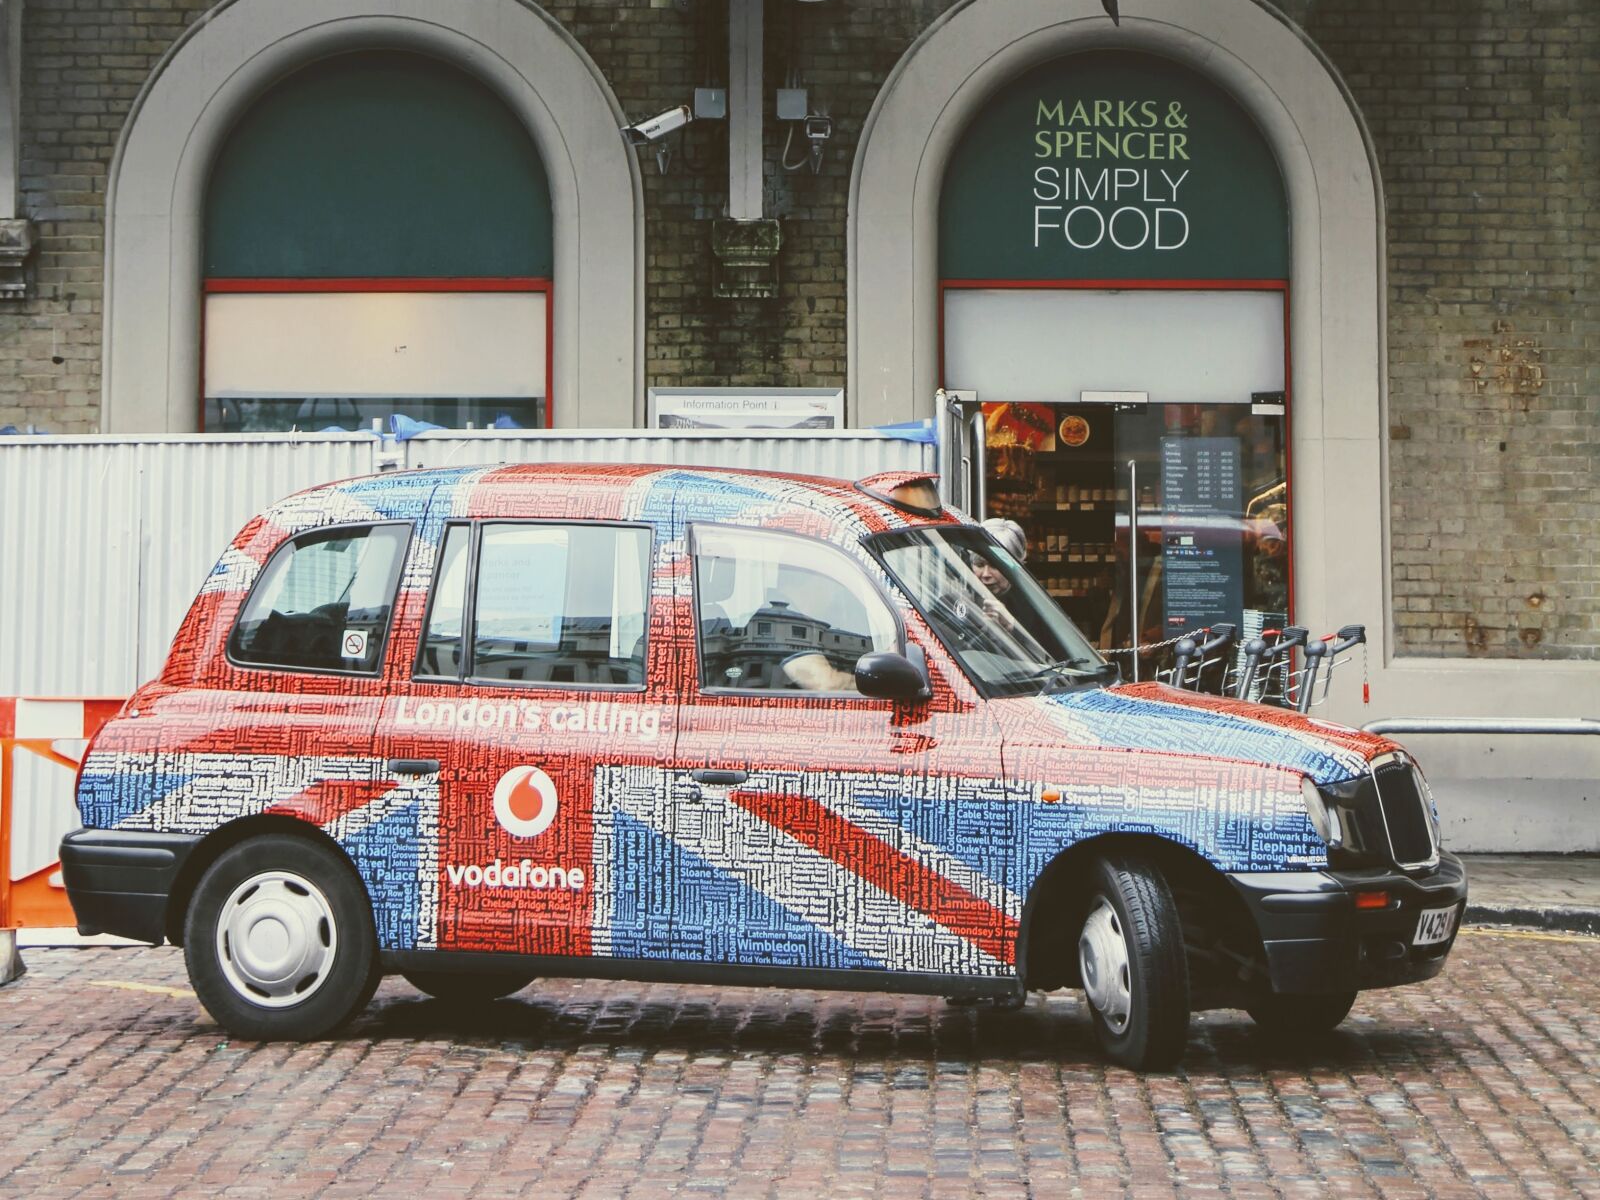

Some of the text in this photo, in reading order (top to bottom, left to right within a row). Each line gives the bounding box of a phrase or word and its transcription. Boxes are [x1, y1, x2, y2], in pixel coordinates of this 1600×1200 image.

[1036, 99, 1188, 129] MARKS &
[1034, 130, 1190, 160] SPENCER
[1033, 166, 1190, 202] SIMPLY
[1034, 205, 1190, 250] FOOD
[683, 400, 767, 410] Information Point
[390, 501, 422, 512] Maida
[688, 504, 713, 514] Green
[656, 604, 689, 616] Street
[657, 642, 668, 682] Street
[680, 649, 692, 704] Watney Market
[397, 696, 543, 731] London's
[550, 701, 660, 742] calling
[312, 732, 370, 744] Paddington
[665, 758, 744, 769] Oxford Circus
[752, 762, 804, 774] Piccadilly
[938, 763, 1014, 774] Farringdon Street
[461, 770, 488, 782] Park
[923, 750, 938, 808] Liverpool
[960, 776, 990, 788] Tower
[1044, 774, 1079, 783] Barbican
[94, 782, 113, 790] Street
[594, 765, 603, 812] Seymour
[608, 766, 621, 813] Oxford
[1138, 778, 1195, 788] Bishopsgate
[94, 791, 112, 803] Hill
[938, 772, 948, 814] Moorgate
[1066, 794, 1102, 805] Street
[446, 782, 456, 828] Gardens
[957, 802, 988, 810] Edward
[487, 800, 495, 828] Place
[850, 806, 898, 818] Haymarket
[899, 768, 914, 862] Charing Cross
[947, 772, 958, 852] Colchester Street
[984, 812, 1010, 820] Street
[382, 814, 414, 824] Queen's
[1033, 819, 1110, 831] Stonecutter Street
[1087, 812, 1182, 826] Victoria Embankment
[376, 824, 447, 837] Bridge Place
[558, 804, 567, 852] Broadway
[1029, 828, 1072, 838] Fenchurch
[1119, 824, 1180, 834] Cannon Street
[346, 835, 396, 844] Herrick Street
[784, 830, 815, 842] Soho
[956, 835, 990, 846] Goswell
[1252, 830, 1300, 842] Southwark
[724, 826, 732, 860] Covent
[916, 841, 946, 852] Temple
[956, 844, 986, 855] Duke's
[1252, 841, 1328, 855] Elephant and
[625, 830, 637, 890] Belgravia
[680, 859, 762, 870] Royal Hospital Chelsea
[1028, 853, 1036, 874] Road
[1250, 852, 1290, 864] Borough
[1287, 856, 1328, 864] UBIQUITOUS
[1232, 862, 1272, 871] The Oval
[376, 869, 447, 882] Palace Road
[446, 859, 585, 890] vodafone
[608, 835, 618, 916] New King's Road
[653, 837, 662, 914] Chester Square
[664, 834, 672, 914] Beauchamp Place
[680, 867, 746, 880] Sloane Square
[981, 856, 989, 900] York Road
[636, 832, 646, 930] Old Brompton Road
[930, 858, 938, 911] Bushey Road
[388, 890, 404, 898] Row
[496, 889, 570, 903] Knightsbridge
[1006, 866, 1014, 927] Waterloo
[385, 902, 402, 910] Place
[401, 882, 412, 920] Street
[482, 898, 570, 912] Chelsea Bridge Road
[938, 896, 990, 910] Lambeth
[418, 882, 432, 940] Victoria
[737, 880, 746, 938] Fulham Road
[784, 913, 828, 924] The Avenue
[844, 886, 855, 949] Battersea
[906, 910, 956, 925] Clapham
[390, 910, 398, 940] Place
[678, 924, 704, 932] Common
[704, 900, 713, 961] Palace Road
[728, 892, 737, 962] Sloane Street
[784, 922, 834, 934] Elspeth Road
[936, 924, 996, 939] Bermondsey
[628, 930, 646, 938] Road
[680, 931, 703, 940] Road
[748, 930, 806, 940] Latchmere Road
[738, 938, 806, 954] Wimbledon
[739, 955, 791, 965] Old York Road
[844, 950, 888, 959] Falcon Road
[844, 958, 886, 968] Ram Street
